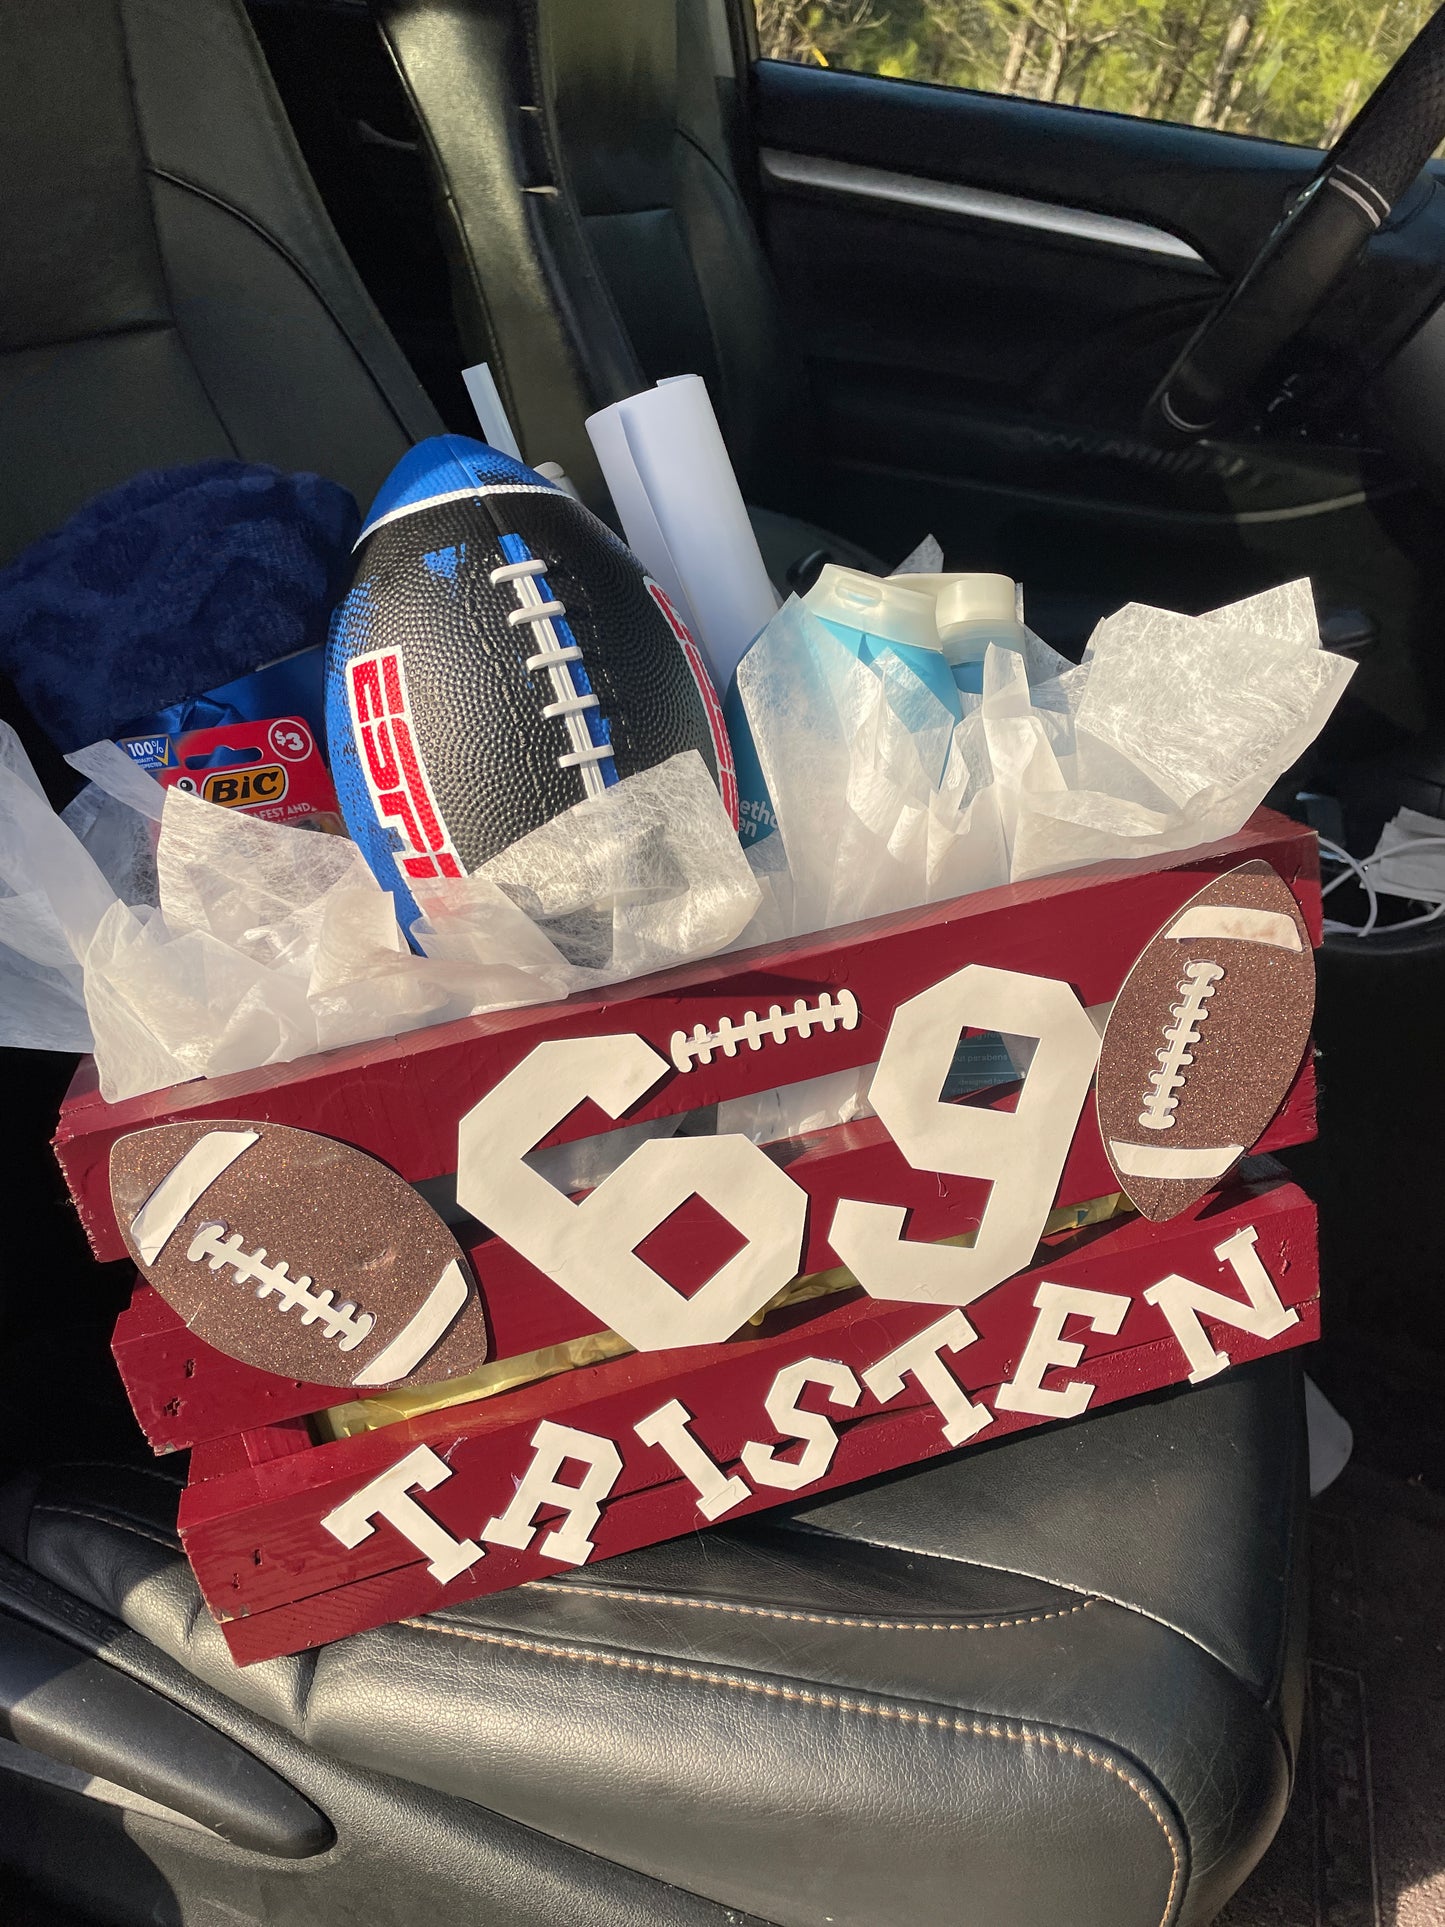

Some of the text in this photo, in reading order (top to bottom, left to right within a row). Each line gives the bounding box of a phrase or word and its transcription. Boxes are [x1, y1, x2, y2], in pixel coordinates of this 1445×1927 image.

[127, 739, 164, 757] 100%
[275, 729, 304, 751] $3
[253, 807, 284, 819] AFEST
[287, 802, 311, 814] AND
[740, 800, 778, 829] etho
[739, 817, 757, 838] en
[457, 964, 1101, 1352] 69
[320, 1225, 1300, 1584] TRISTEN
